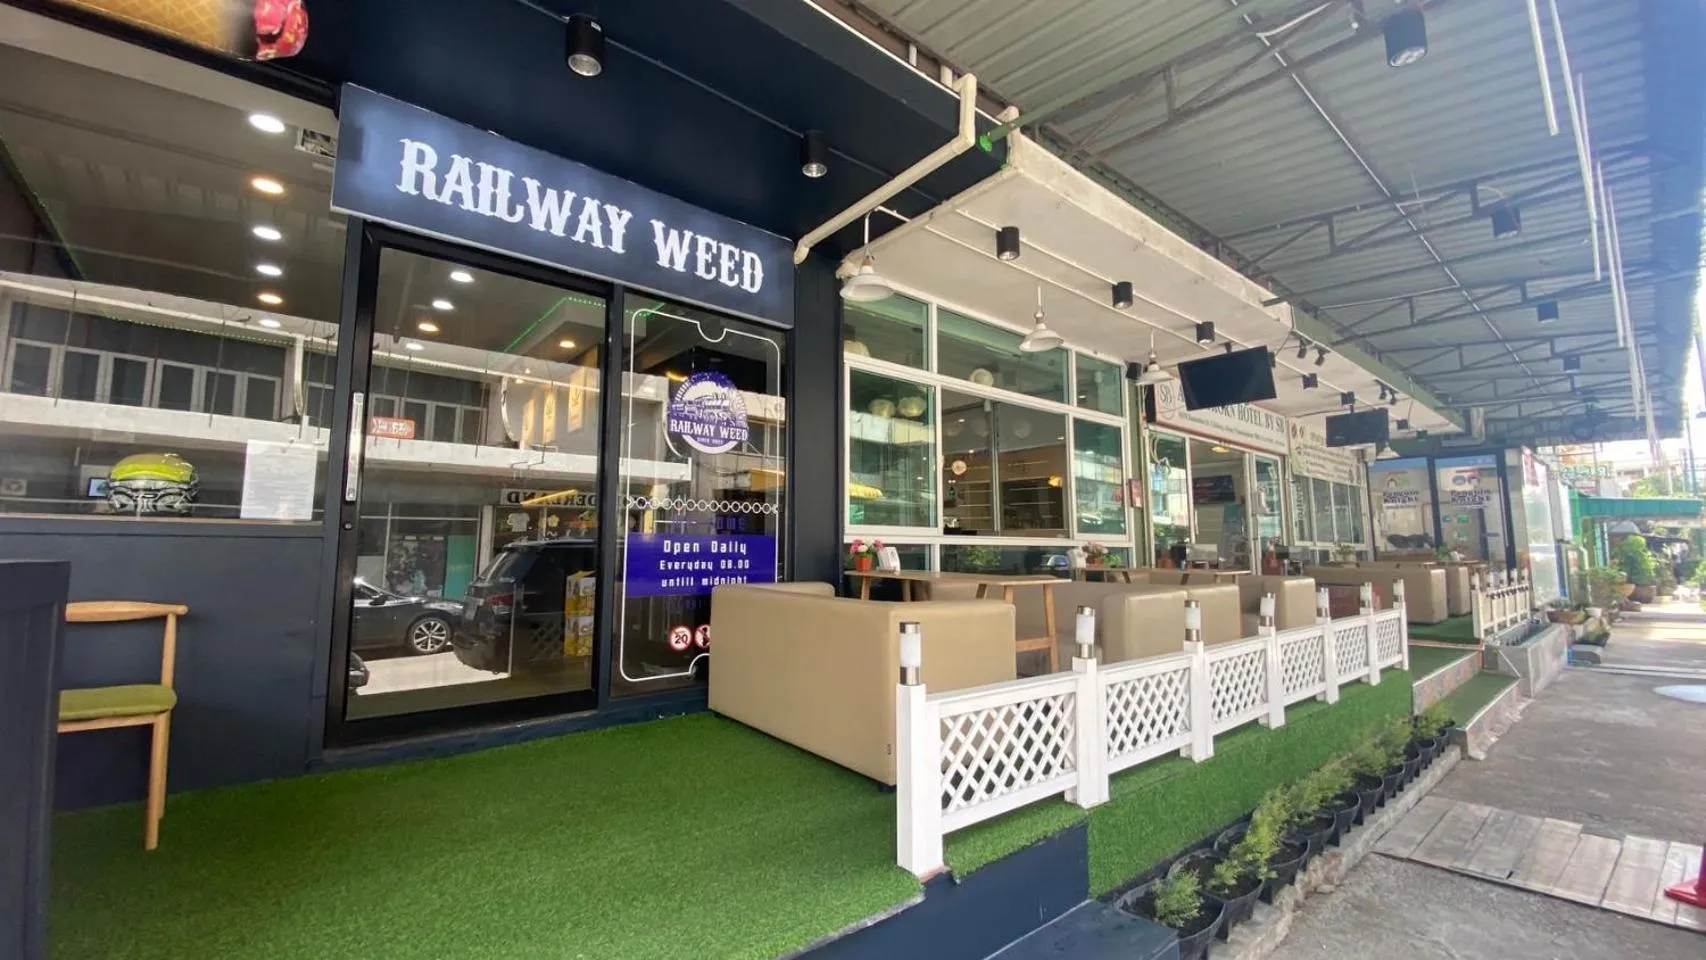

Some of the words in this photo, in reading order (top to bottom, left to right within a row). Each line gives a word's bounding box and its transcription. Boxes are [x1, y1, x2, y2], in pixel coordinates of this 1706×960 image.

[396, 138, 633, 254] RAILWAY
[650, 219, 764, 294] WEED
[670, 419, 717, 437] RAILWAY
[720, 426, 748, 441] WEED
[663, 539, 700, 556] Open
[711, 540, 747, 556] Daily
[659, 559, 713, 571] Everyday
[674, 633, 688, 644] 20
